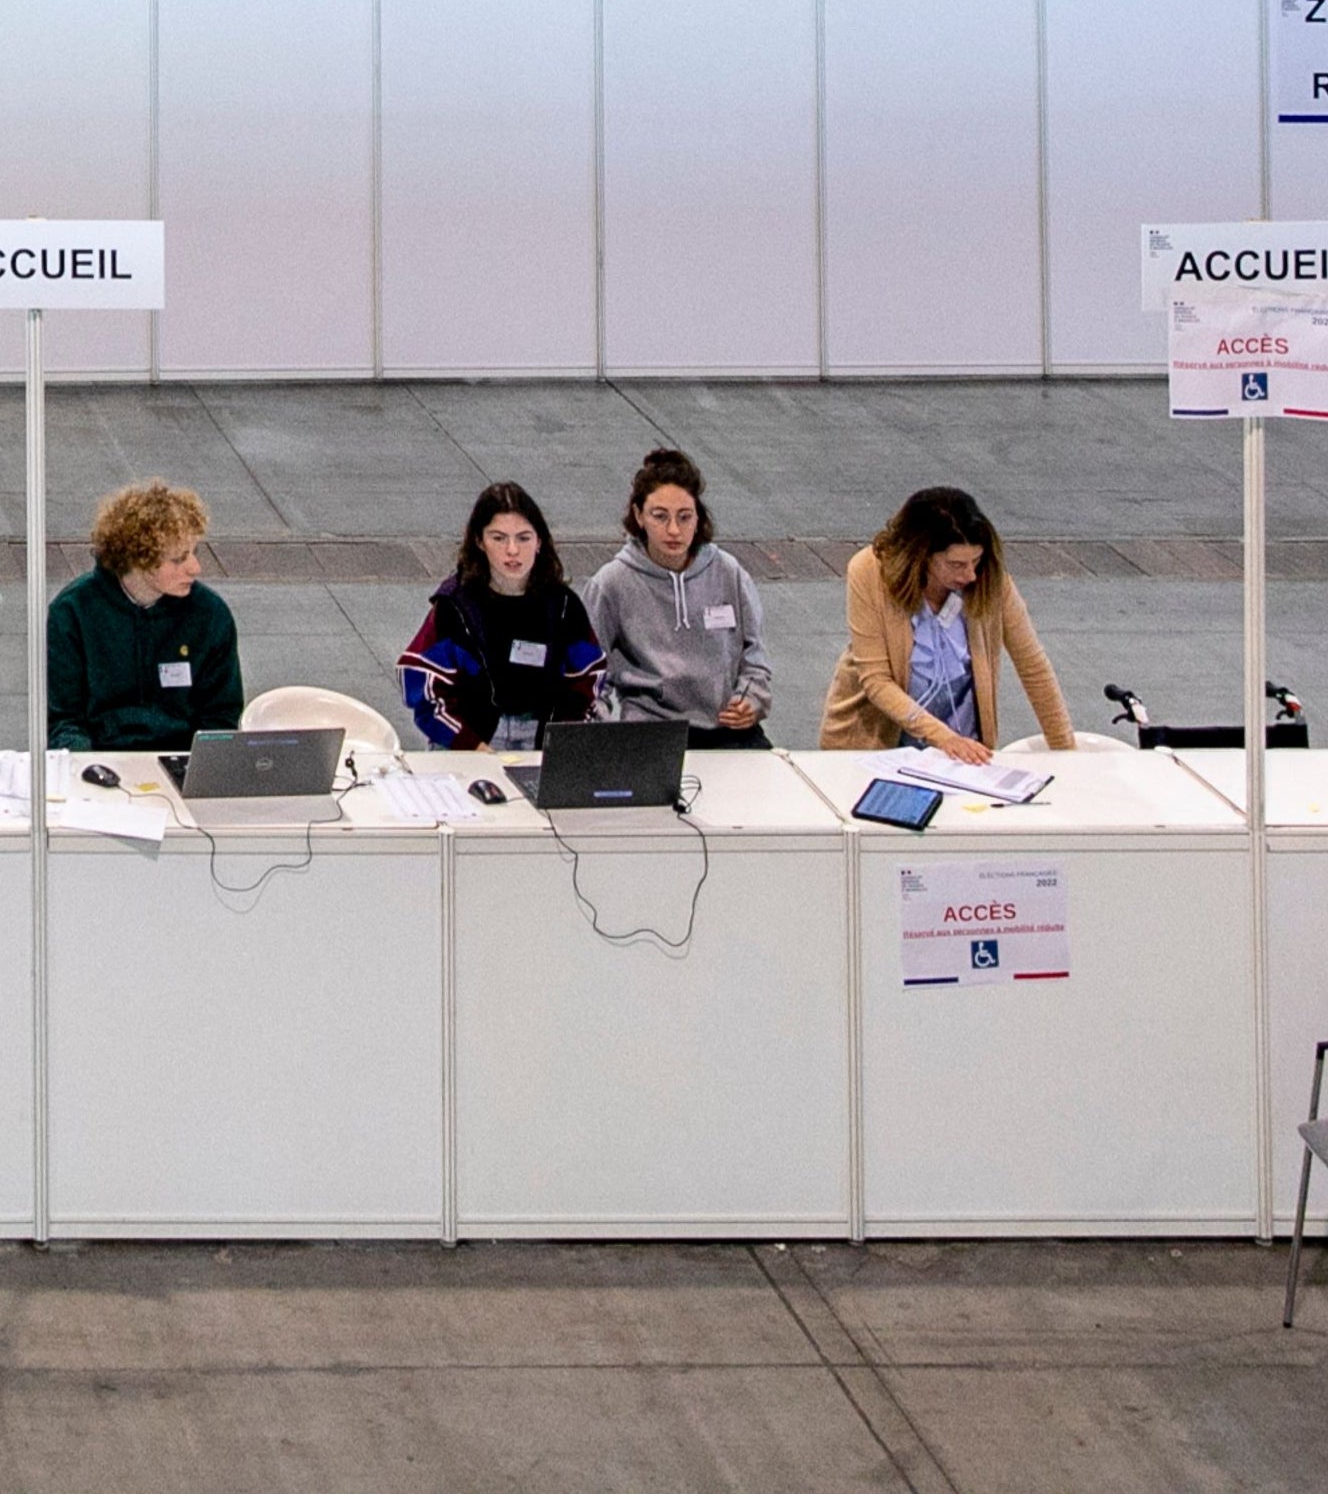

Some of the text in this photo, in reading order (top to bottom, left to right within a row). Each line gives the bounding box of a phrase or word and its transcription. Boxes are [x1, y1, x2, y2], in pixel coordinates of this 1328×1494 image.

[1216, 333, 1290, 356] ACCÈS
[1035, 877, 1058, 888] 2022
[943, 899, 1017, 923] ACCÈS
